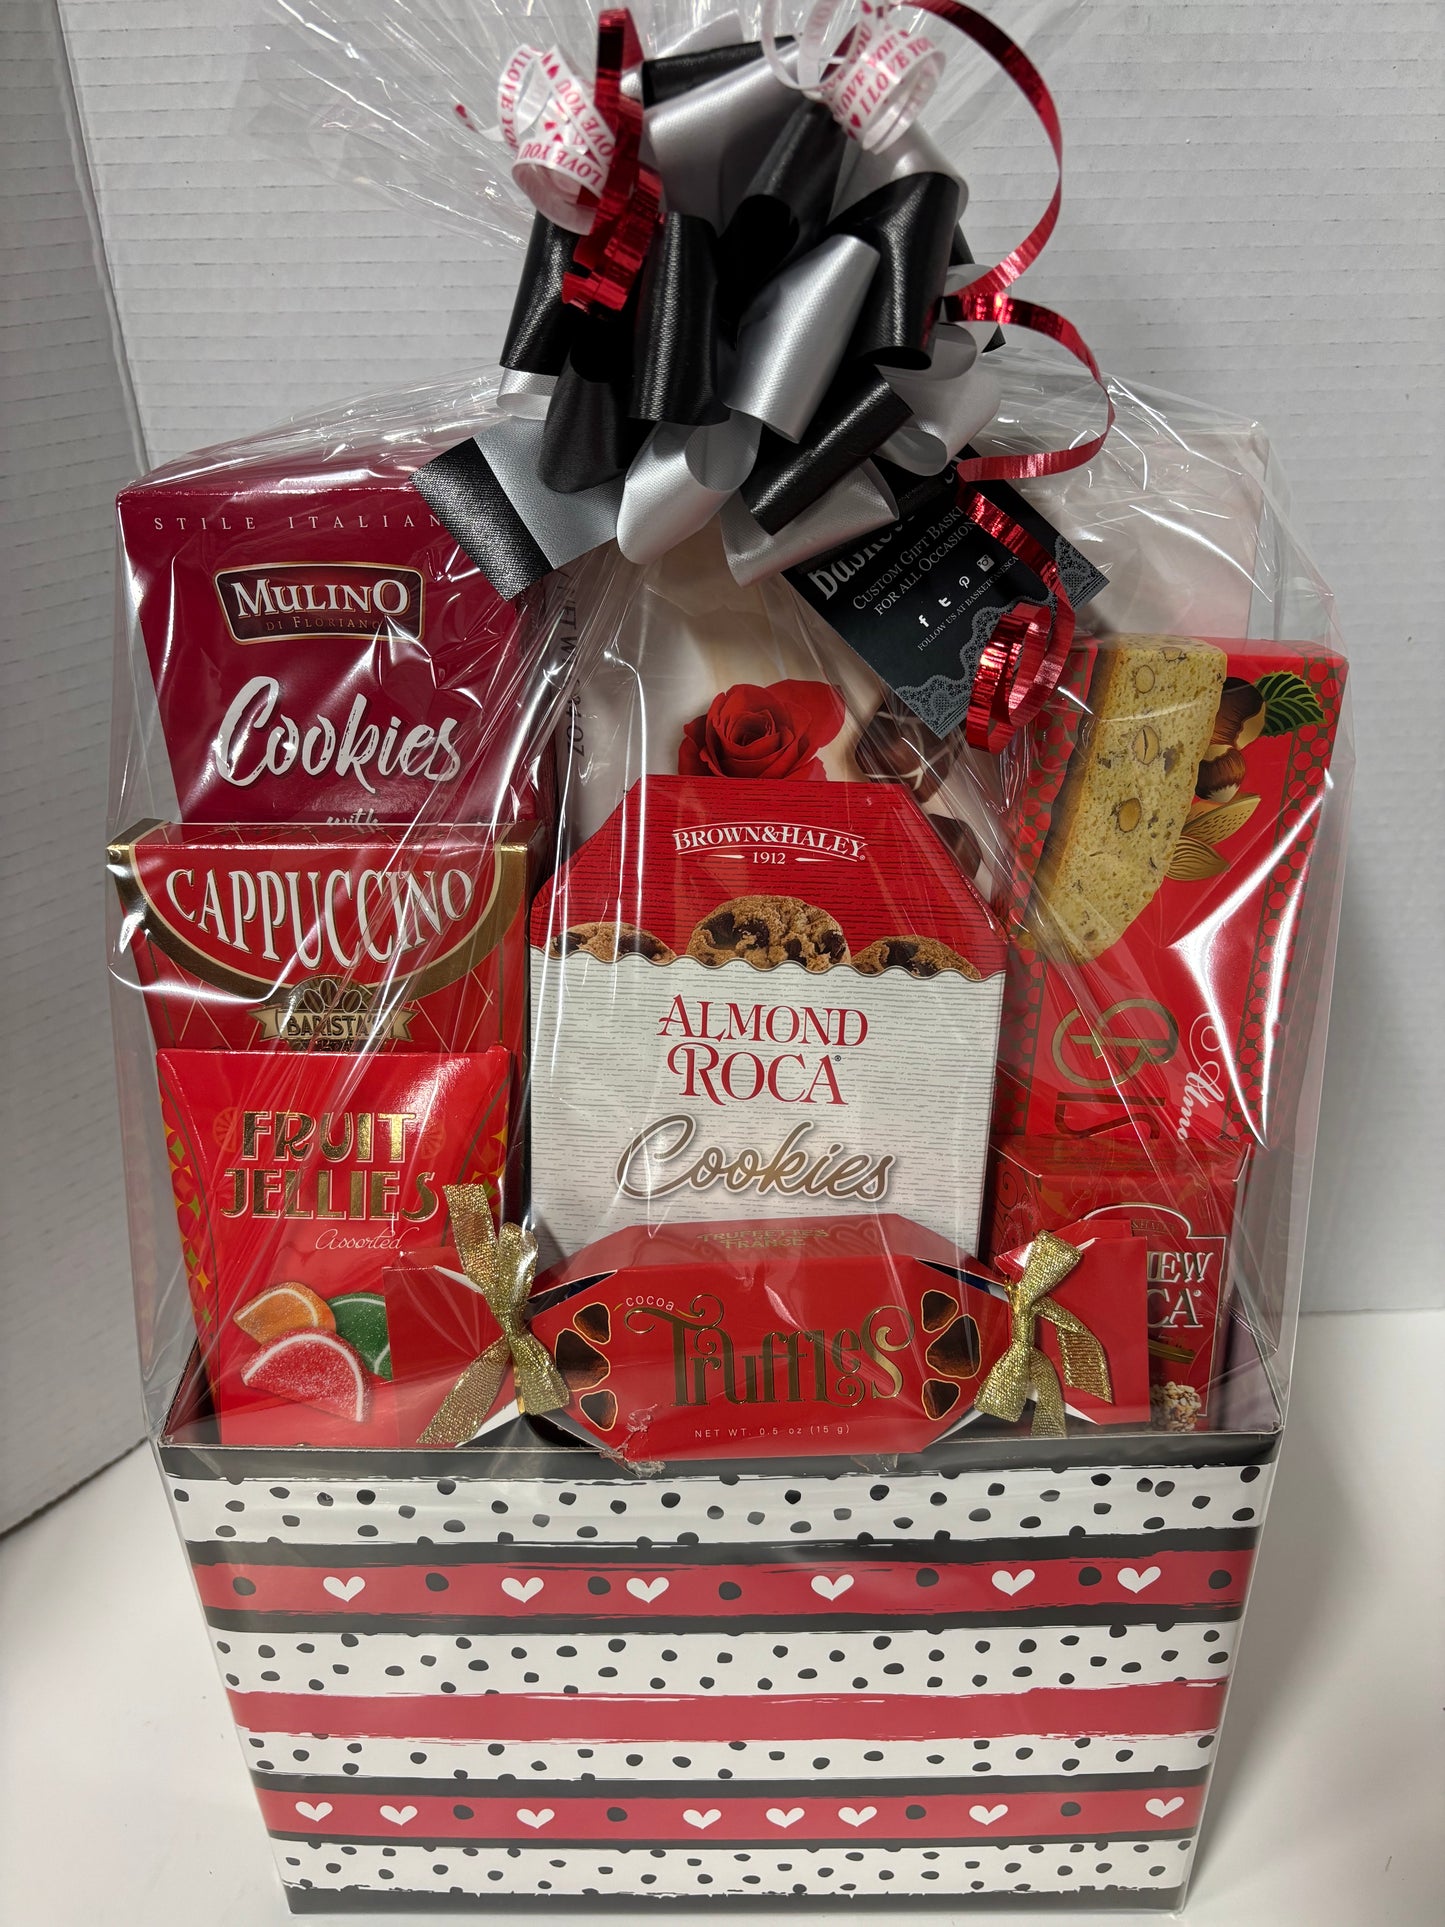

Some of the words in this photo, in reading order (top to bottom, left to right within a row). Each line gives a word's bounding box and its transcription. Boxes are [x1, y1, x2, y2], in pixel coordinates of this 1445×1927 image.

[866, 50, 910, 104] LOVE
[906, 37, 934, 57] YO
[554, 79, 587, 116] YOU
[521, 142, 551, 159] YOU
[581, 116, 616, 157] OVE
[555, 150, 602, 187] LOVE
[153, 515, 258, 532] STILE
[287, 515, 442, 531] ITALIAN
[852, 562, 903, 610] CUSTOM
[900, 536, 931, 565] GIFT
[926, 505, 964, 541] BASK
[873, 591, 900, 616] FOR
[900, 571, 922, 594] ALL
[918, 520, 977, 572] OCCASION
[266, 618, 286, 632] DI
[291, 615, 383, 632] FLORIANO
[917, 621, 947, 652] FOLLOW
[945, 612, 957, 625] US
[956, 603, 967, 616] AT
[215, 675, 462, 795] Cookies
[751, 850, 787, 866] 1912
[165, 868, 475, 970] CAPPUCCINO
[286, 1012, 386, 1037] BARISTA'S
[656, 994, 868, 1048] ALMOND
[666, 1042, 849, 1107] ROCA
[1176, 1012, 1226, 1142] Almo
[241, 1109, 417, 1163] FRUIT
[614, 1114, 897, 1203] Cookies
[219, 1167, 441, 1222] JELLIES
[314, 1227, 420, 1250] Assorted
[1147, 1251, 1215, 1286] EW
[624, 1295, 675, 1312] cocoa
[1147, 1287, 1203, 1330] CA
[694, 1428, 721, 1439] NET
[728, 1428, 753, 1438] WT.
[758, 1426, 780, 1437] 0.5
[788, 1427, 804, 1436] oz
[810, 1424, 832, 1436] (15
[836, 1424, 851, 1437] g)
